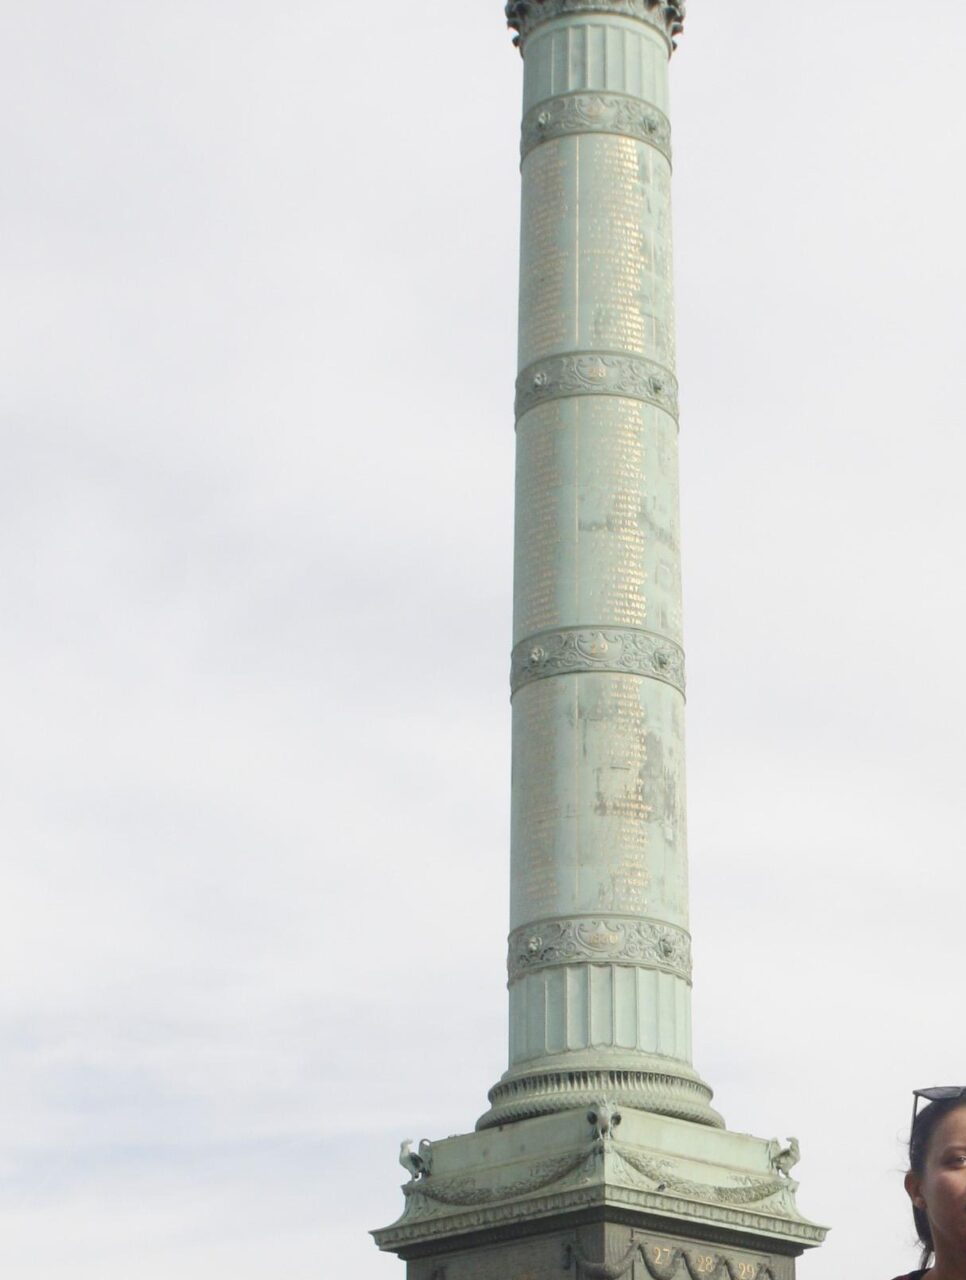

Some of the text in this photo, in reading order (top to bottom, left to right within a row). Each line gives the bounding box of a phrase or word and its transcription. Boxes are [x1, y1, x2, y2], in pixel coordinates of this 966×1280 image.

[653, 1246, 755, 1280] 27 28 29
